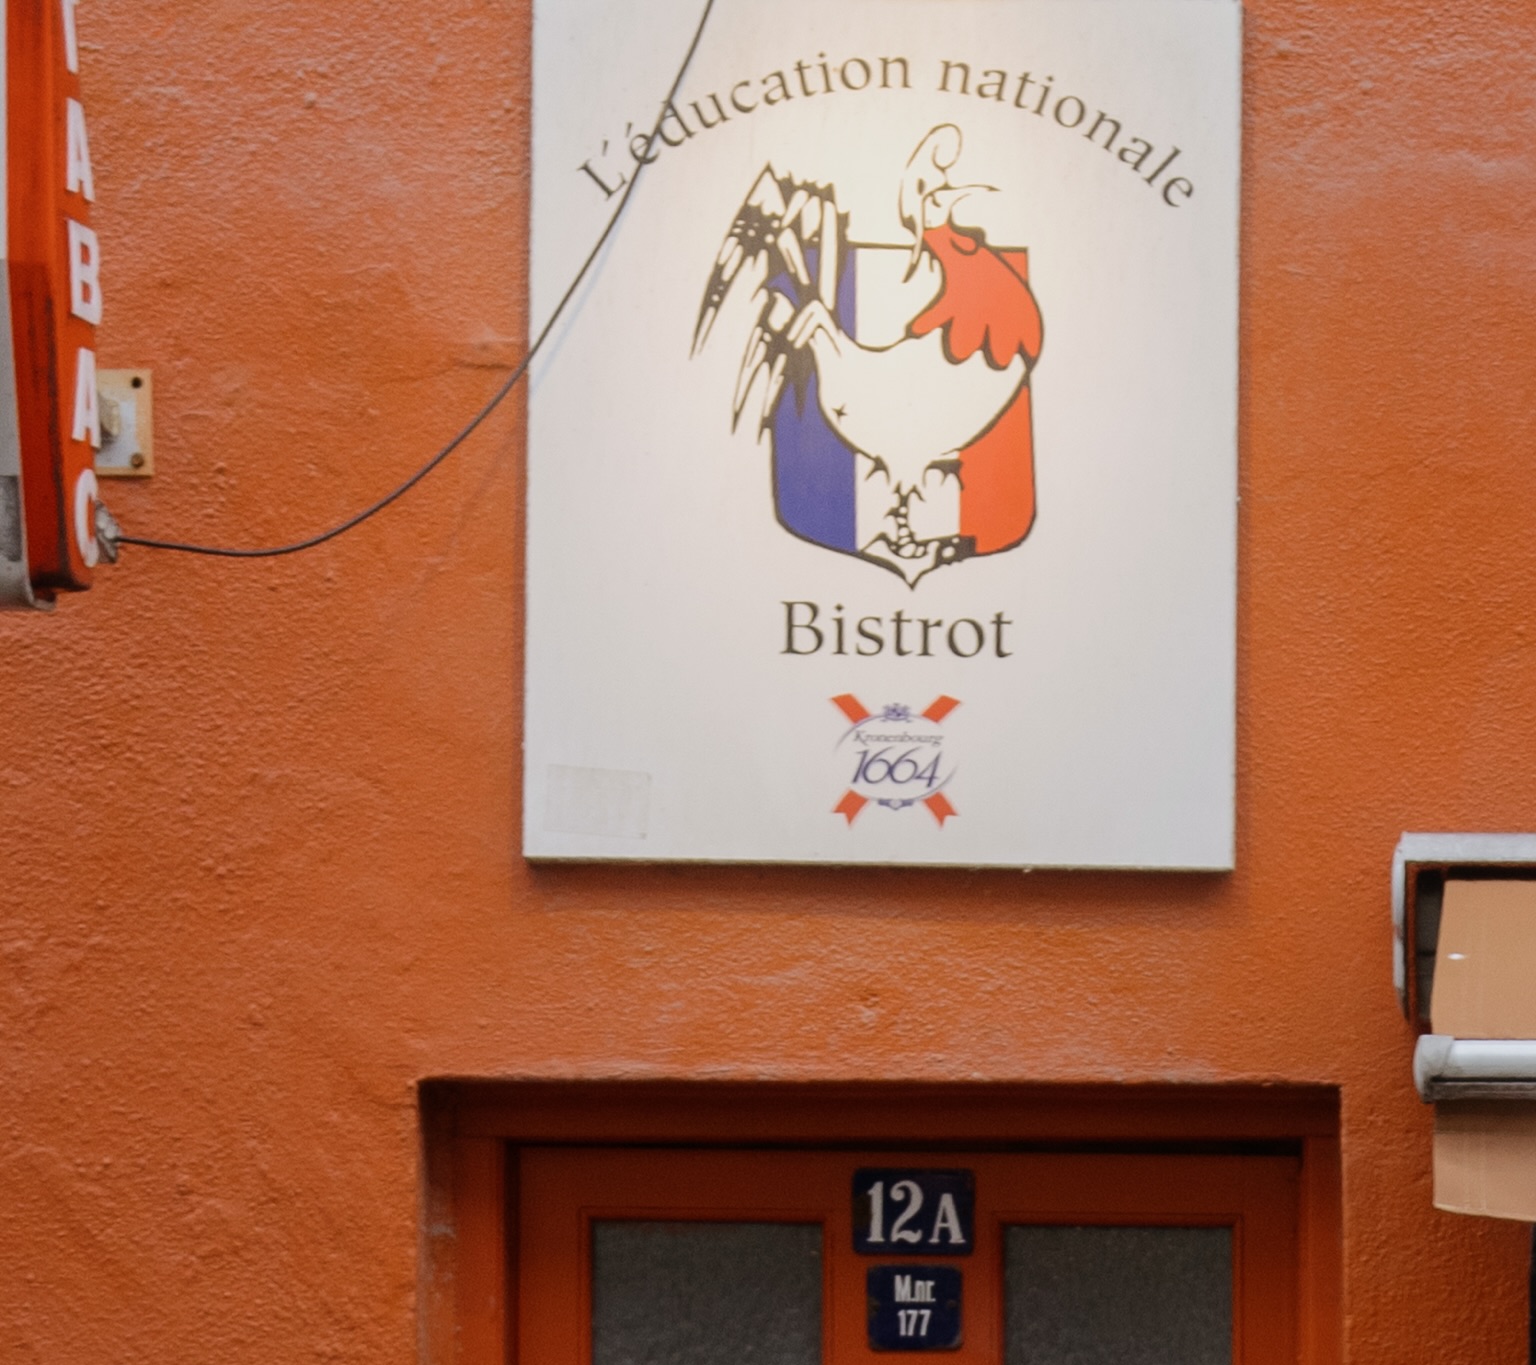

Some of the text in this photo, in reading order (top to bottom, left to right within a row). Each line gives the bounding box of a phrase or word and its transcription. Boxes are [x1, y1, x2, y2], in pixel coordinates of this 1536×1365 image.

[576, 52, 1195, 208] L'éducation nationale
[779, 600, 1013, 660] Bistrot
[852, 747, 943, 788] 1664
[866, 1180, 966, 1243] 12A
[897, 1309, 931, 1336] 177
